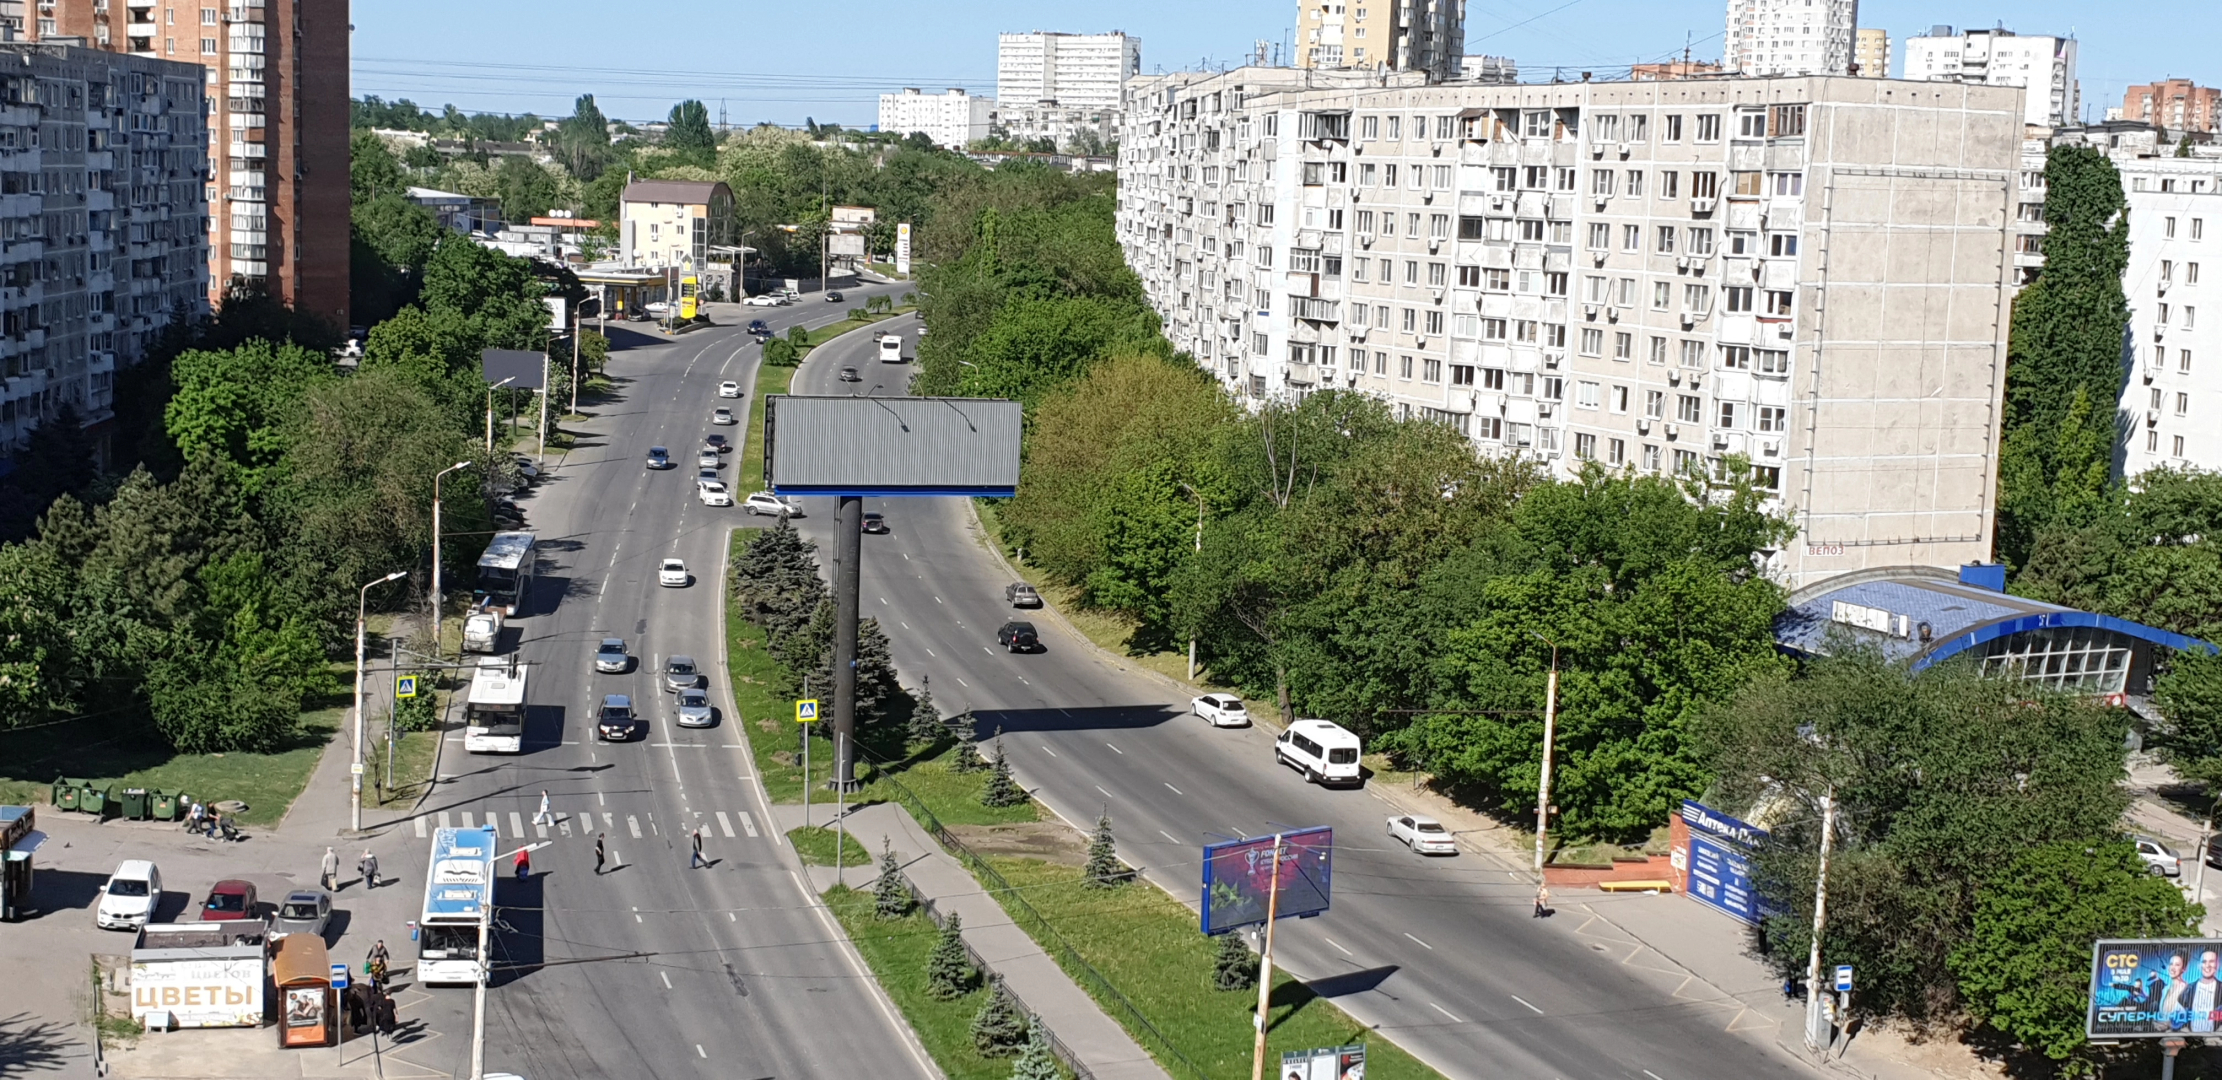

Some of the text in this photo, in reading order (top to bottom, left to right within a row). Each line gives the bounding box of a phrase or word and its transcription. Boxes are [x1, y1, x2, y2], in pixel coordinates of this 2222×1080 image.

[1697, 811, 1736, 838] Аптека
[1260, 847, 1288, 858] FONET
[2106, 954, 2138, 968] СТС
[136, 985, 252, 1008] ЦВЕТЫ
